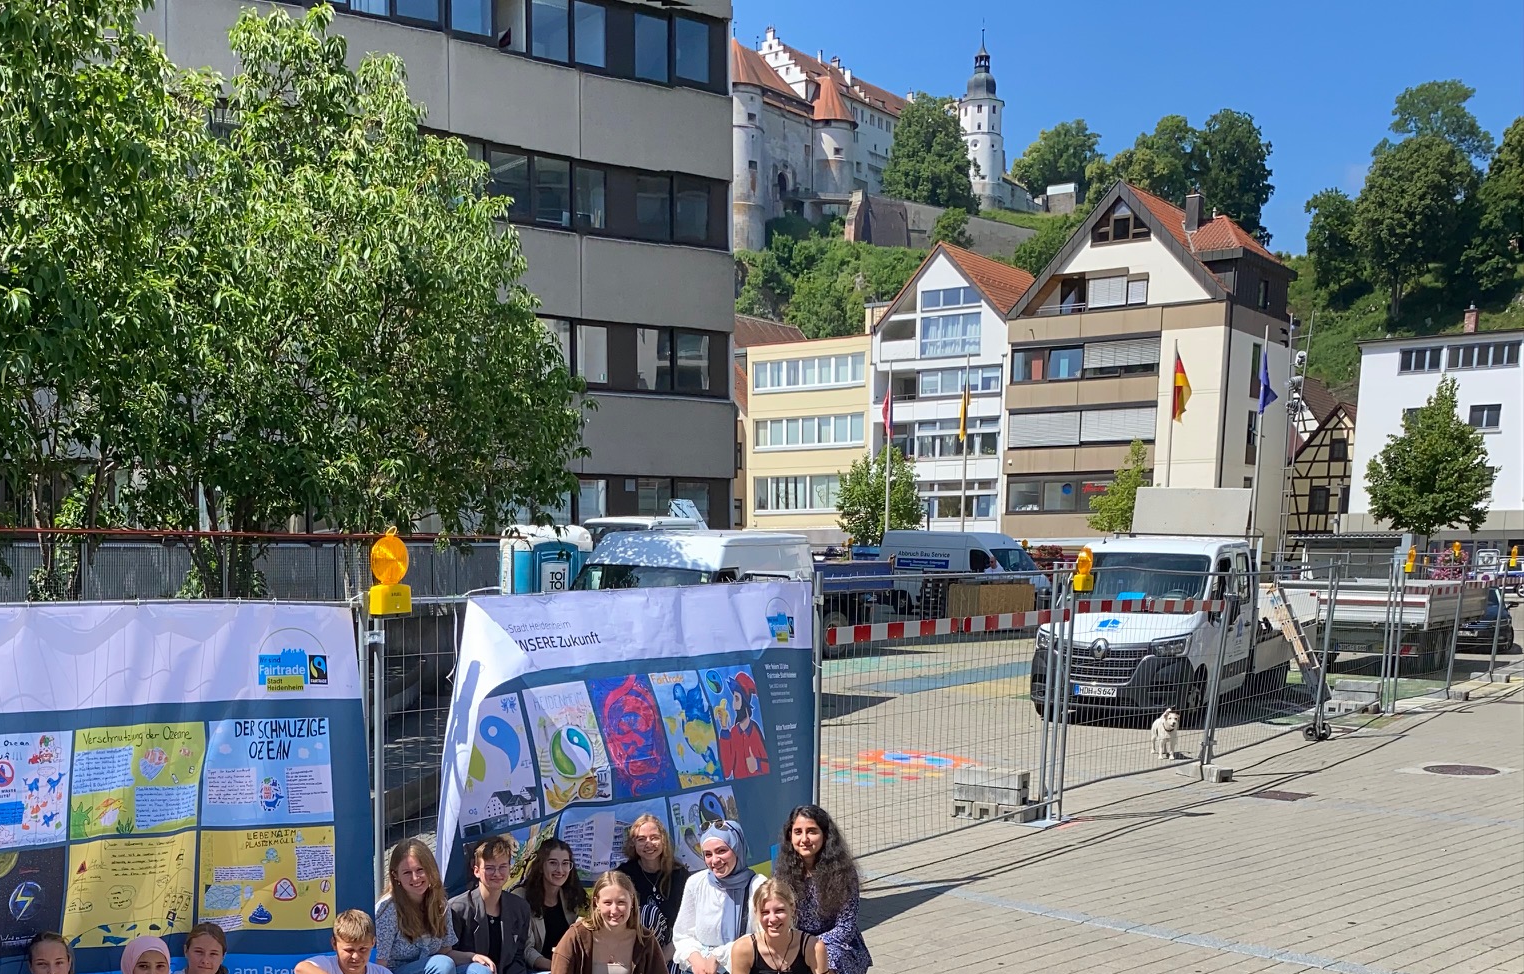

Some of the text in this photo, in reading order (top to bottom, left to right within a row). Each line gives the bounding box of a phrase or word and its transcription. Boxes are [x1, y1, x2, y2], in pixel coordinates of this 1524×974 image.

[529, 620, 571, 631] Heidenheim
[518, 631, 602, 654] NSERE Zukunft
[259, 664, 306, 676] Fairtrade
[82, 725, 192, 747] Verschmutzung der Ozeane
[234, 718, 327, 739] DER SCHMUZIGE
[3, 739, 30, 747] Ozean
[249, 740, 292, 760] OZEAN
